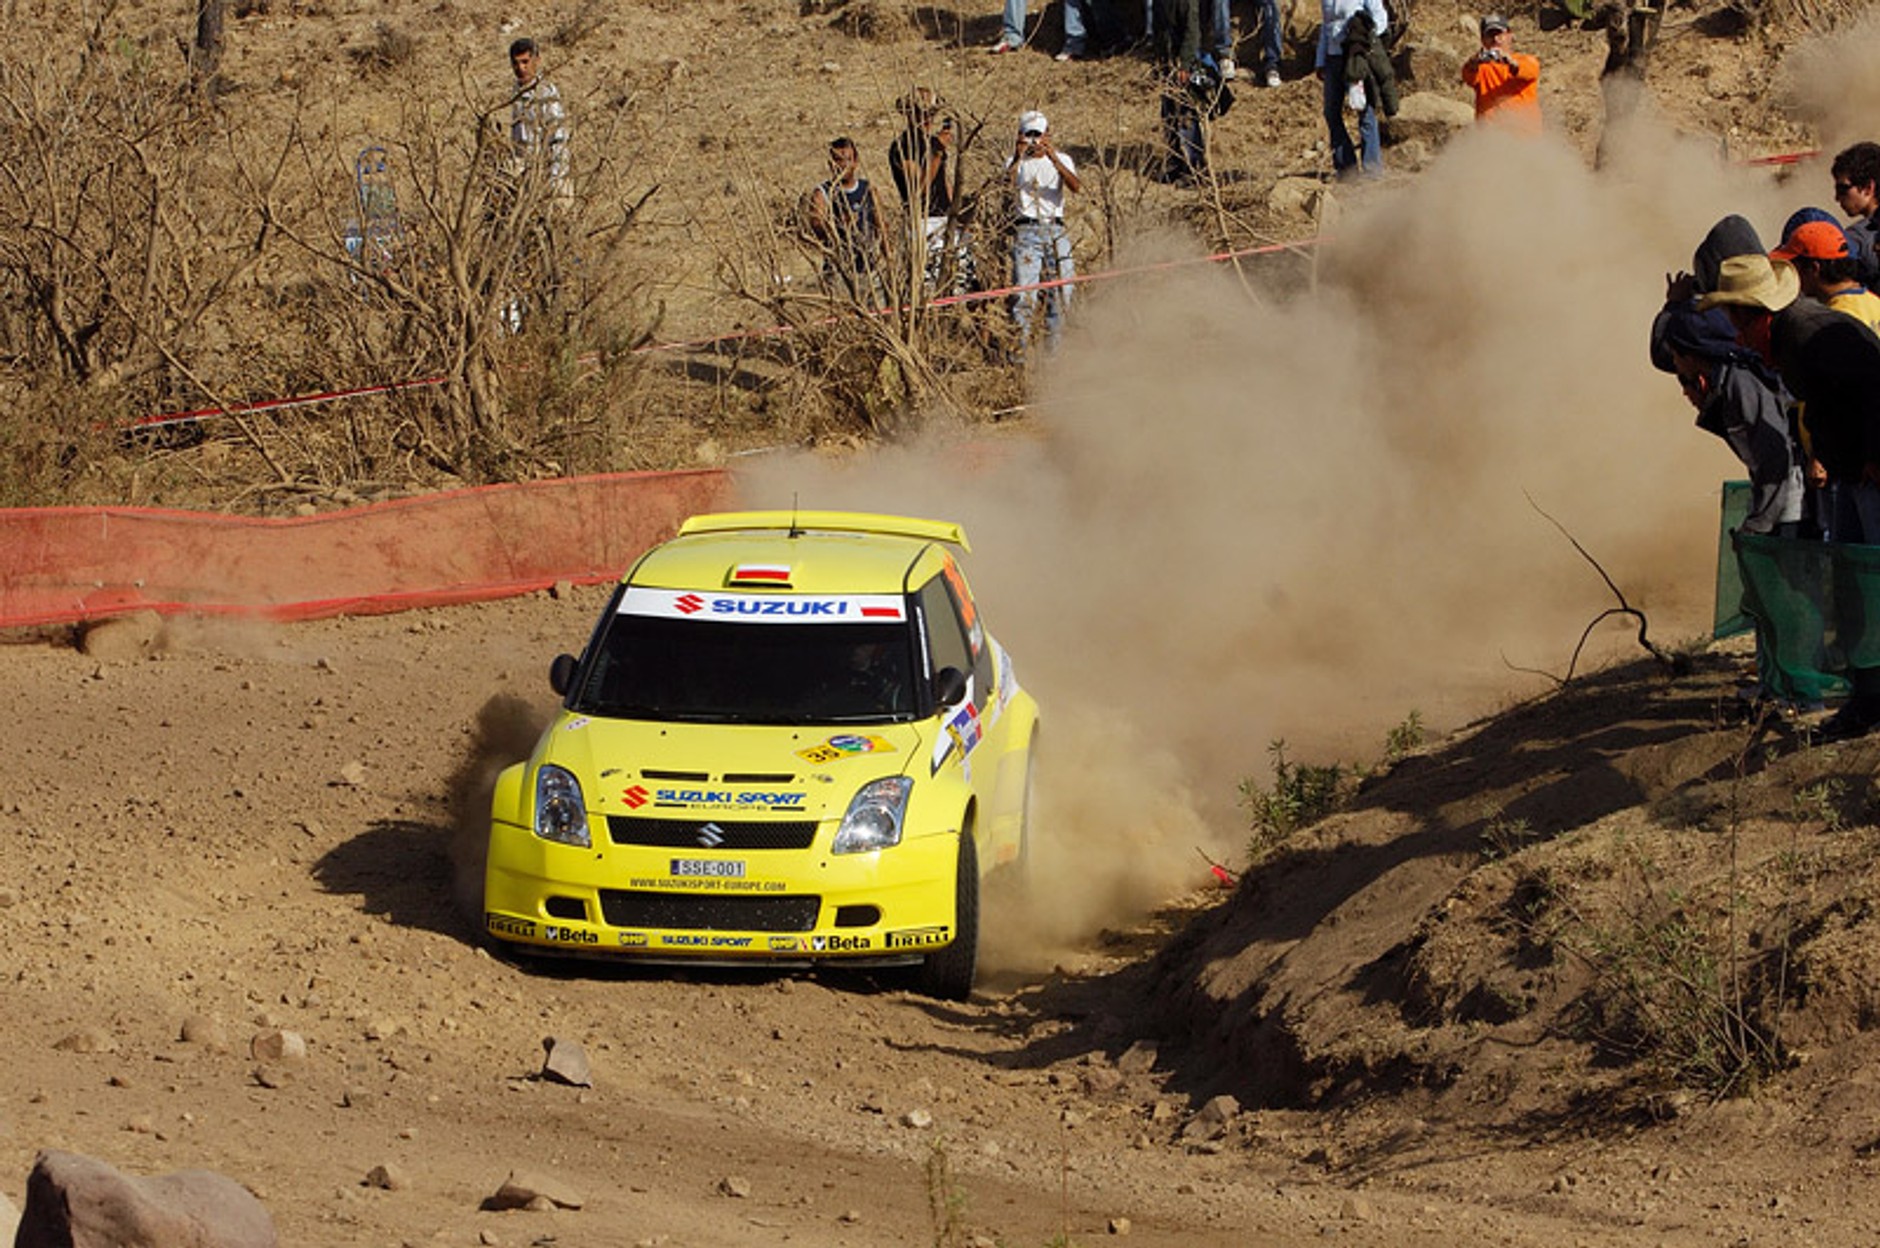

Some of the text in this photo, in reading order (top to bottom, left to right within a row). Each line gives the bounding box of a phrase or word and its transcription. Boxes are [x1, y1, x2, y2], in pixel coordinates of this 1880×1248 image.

[712, 599, 847, 615] SUZUKI
[656, 789, 807, 805] SUZUKI SPORT
[682, 861, 742, 876] SSE-001
[560, 926, 598, 943] Beta
[828, 935, 871, 949] Beta
[884, 925, 949, 949] PIRELLI
